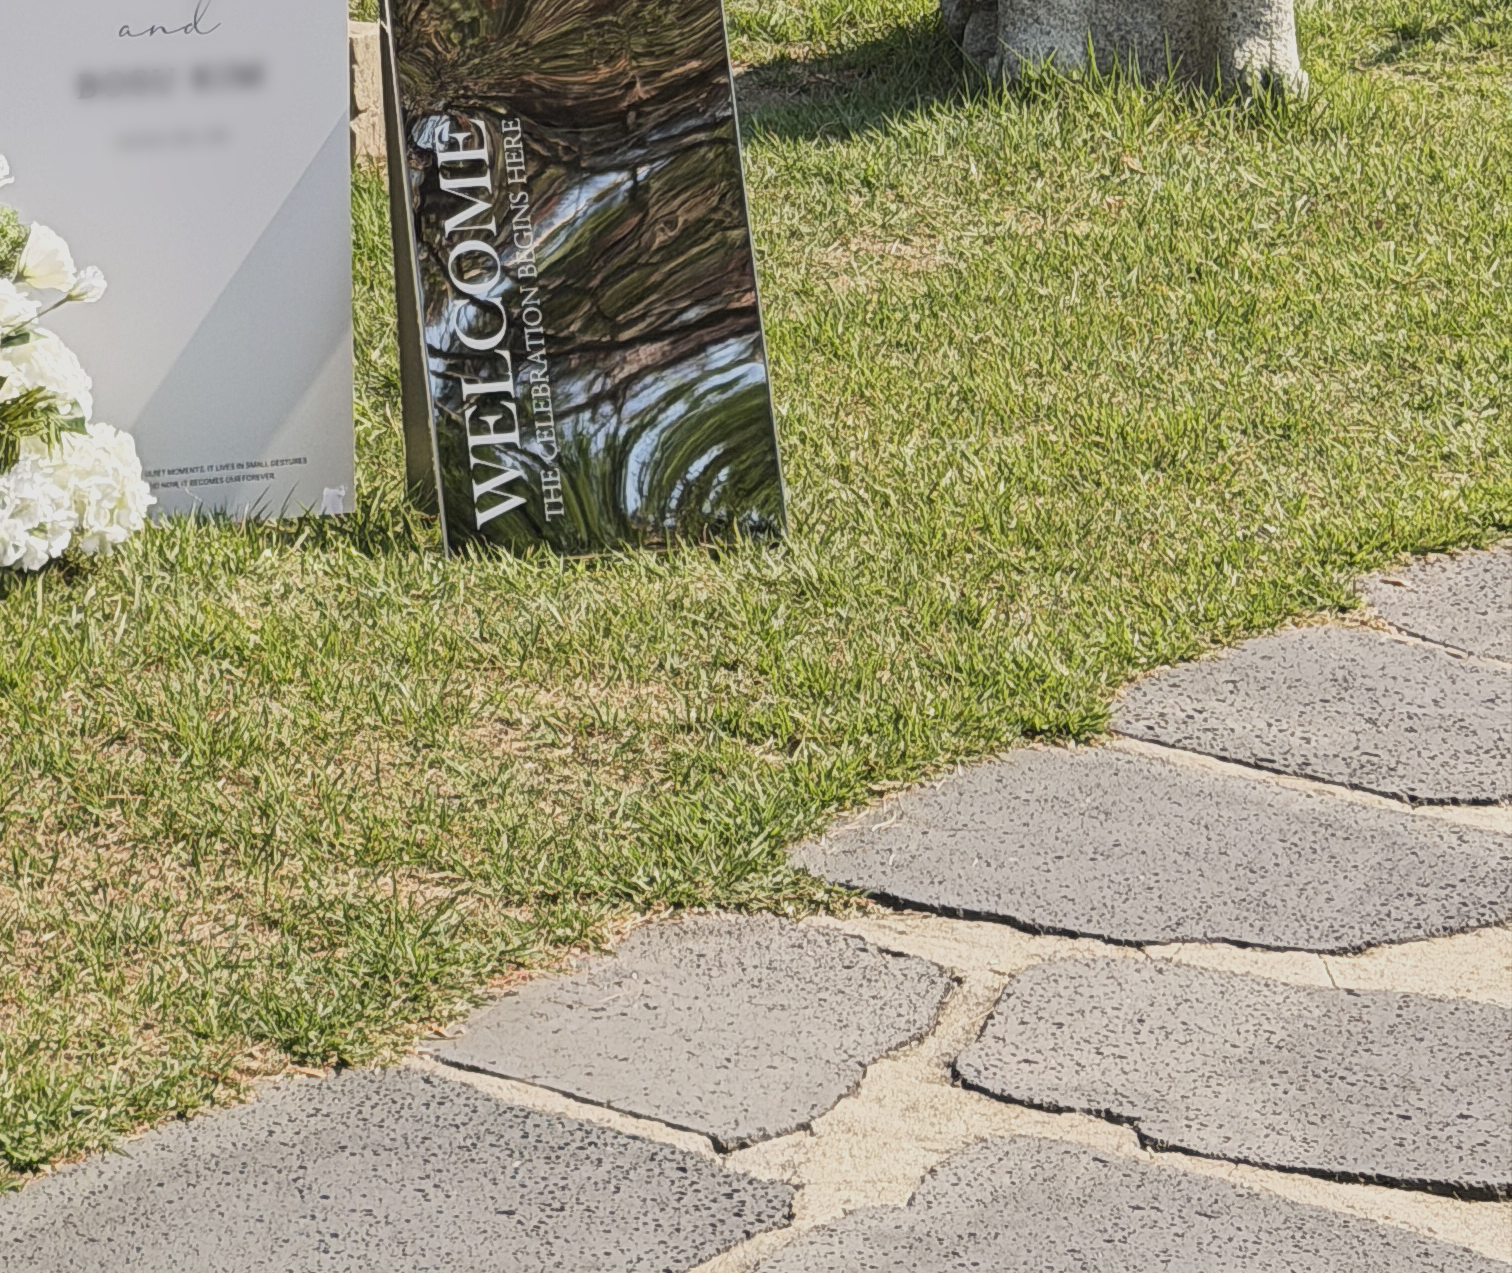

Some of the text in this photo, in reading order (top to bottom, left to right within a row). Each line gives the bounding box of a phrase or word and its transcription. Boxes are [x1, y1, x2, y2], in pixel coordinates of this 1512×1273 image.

[434, 118, 529, 532] WELCOME
[501, 117, 565, 522] THE CELEBRATION BEGINS HERE
